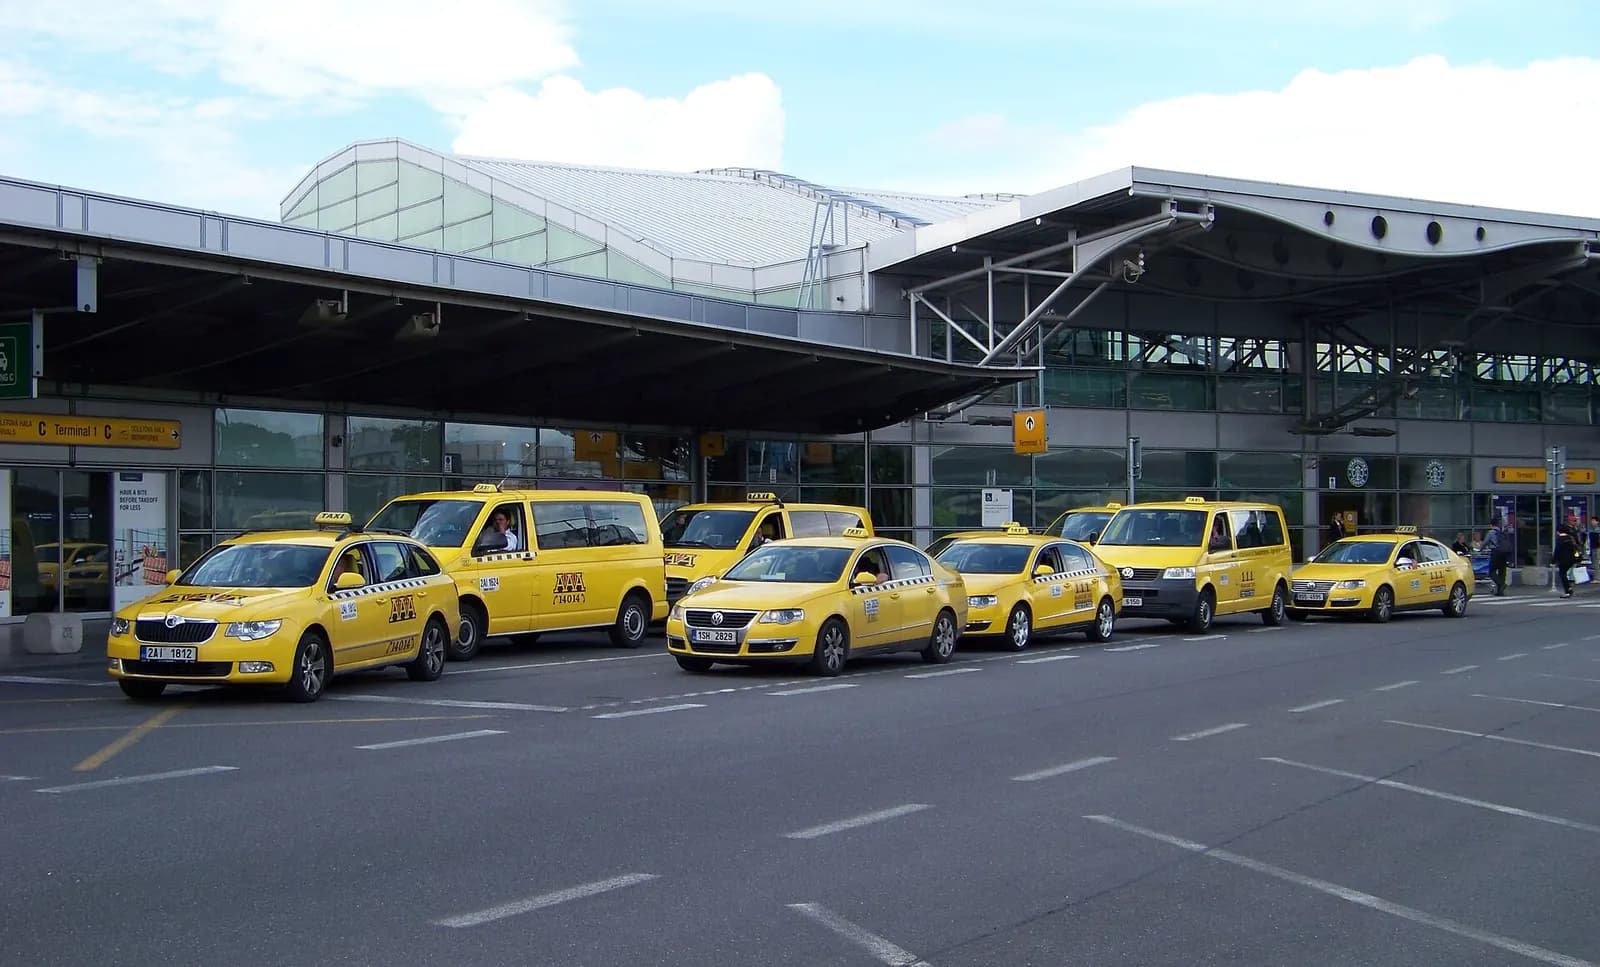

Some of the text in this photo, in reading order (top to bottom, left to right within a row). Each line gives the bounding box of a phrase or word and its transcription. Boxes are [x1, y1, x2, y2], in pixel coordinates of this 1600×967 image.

[38, 421, 112, 439] C Terminal 1 C
[749, 492, 769, 500] TAXI
[553, 572, 586, 593] AAA
[559, 594, 582, 604] 14014
[389, 595, 416, 623] AAA
[698, 631, 733, 640] 1SH 2829
[148, 648, 192, 659] 2AI 1812
